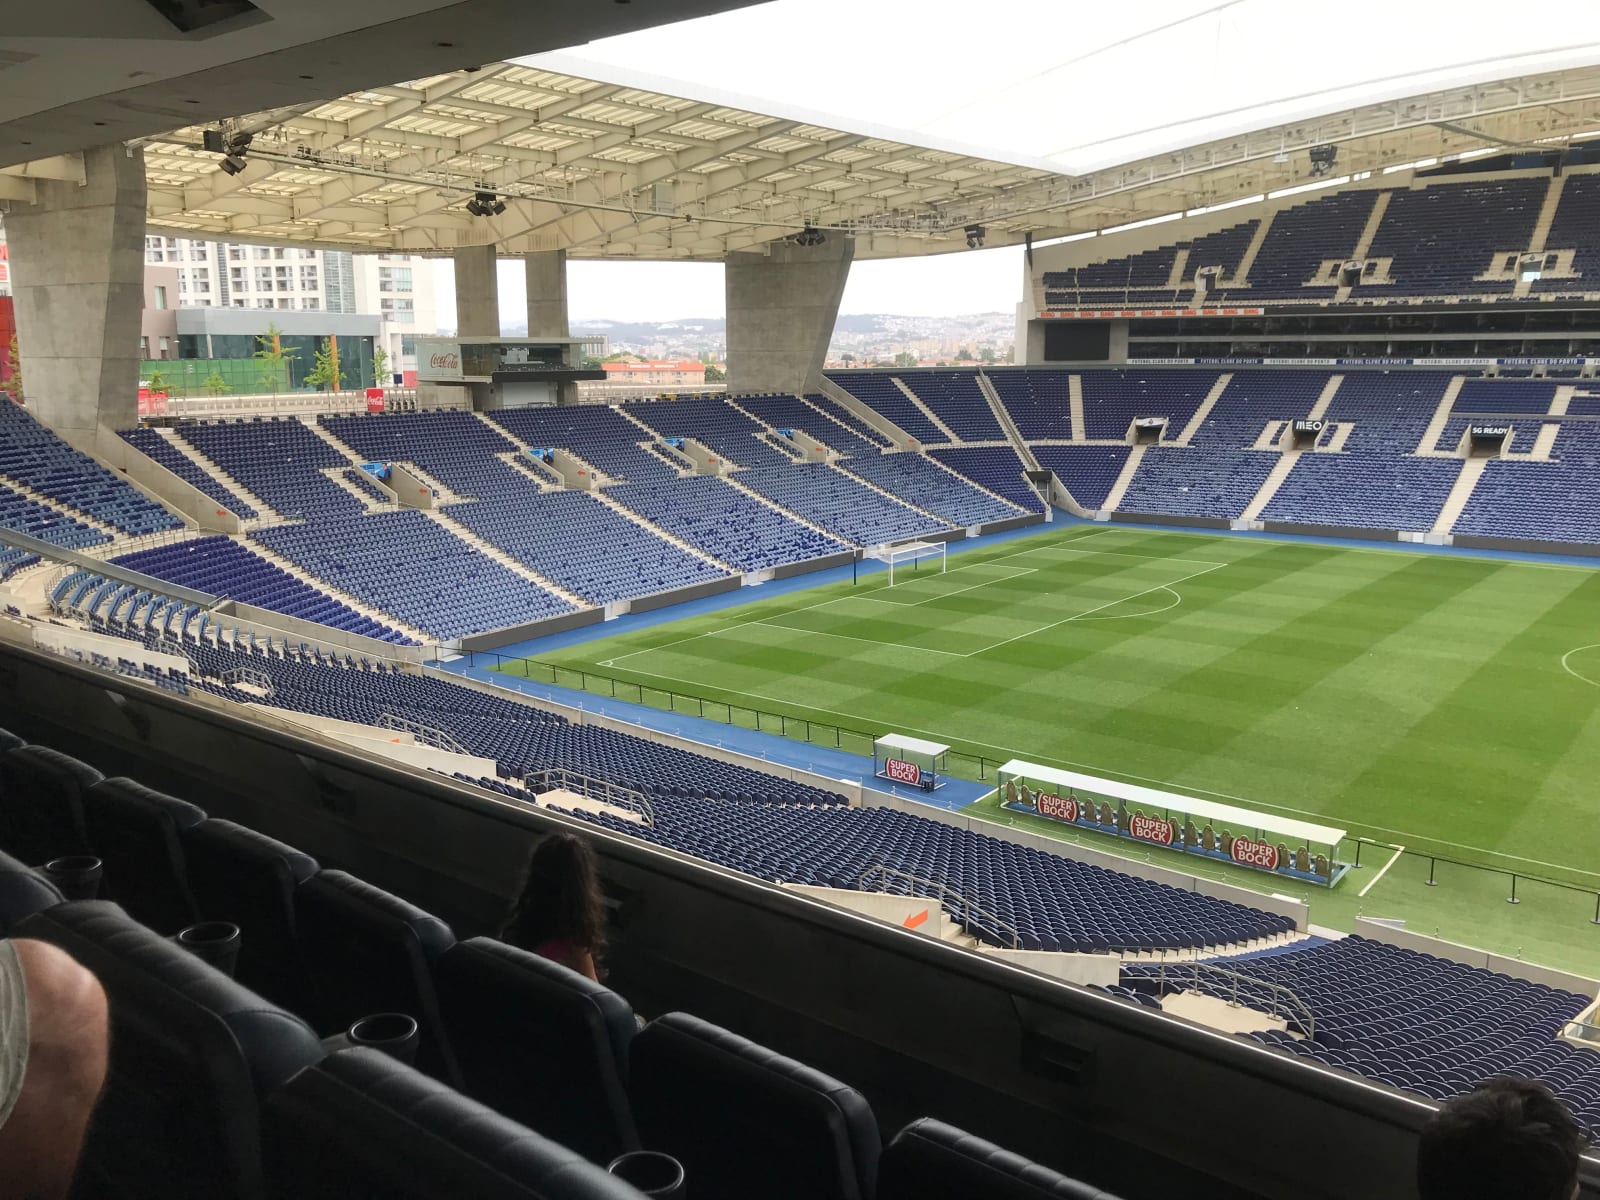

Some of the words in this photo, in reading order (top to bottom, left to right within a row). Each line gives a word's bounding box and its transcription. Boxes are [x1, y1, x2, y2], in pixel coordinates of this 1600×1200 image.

[1296, 421, 1322, 430] MEO
[890, 759, 916, 773] SUPER
[891, 768, 915, 781] BOCK
[1042, 795, 1073, 810] SUPER
[1043, 805, 1071, 819] BOCK
[1135, 817, 1169, 833] SUPER
[1136, 827, 1167, 842] BOCK
[1236, 840, 1273, 857] SUPER
[1238, 850, 1271, 866] BOCK
